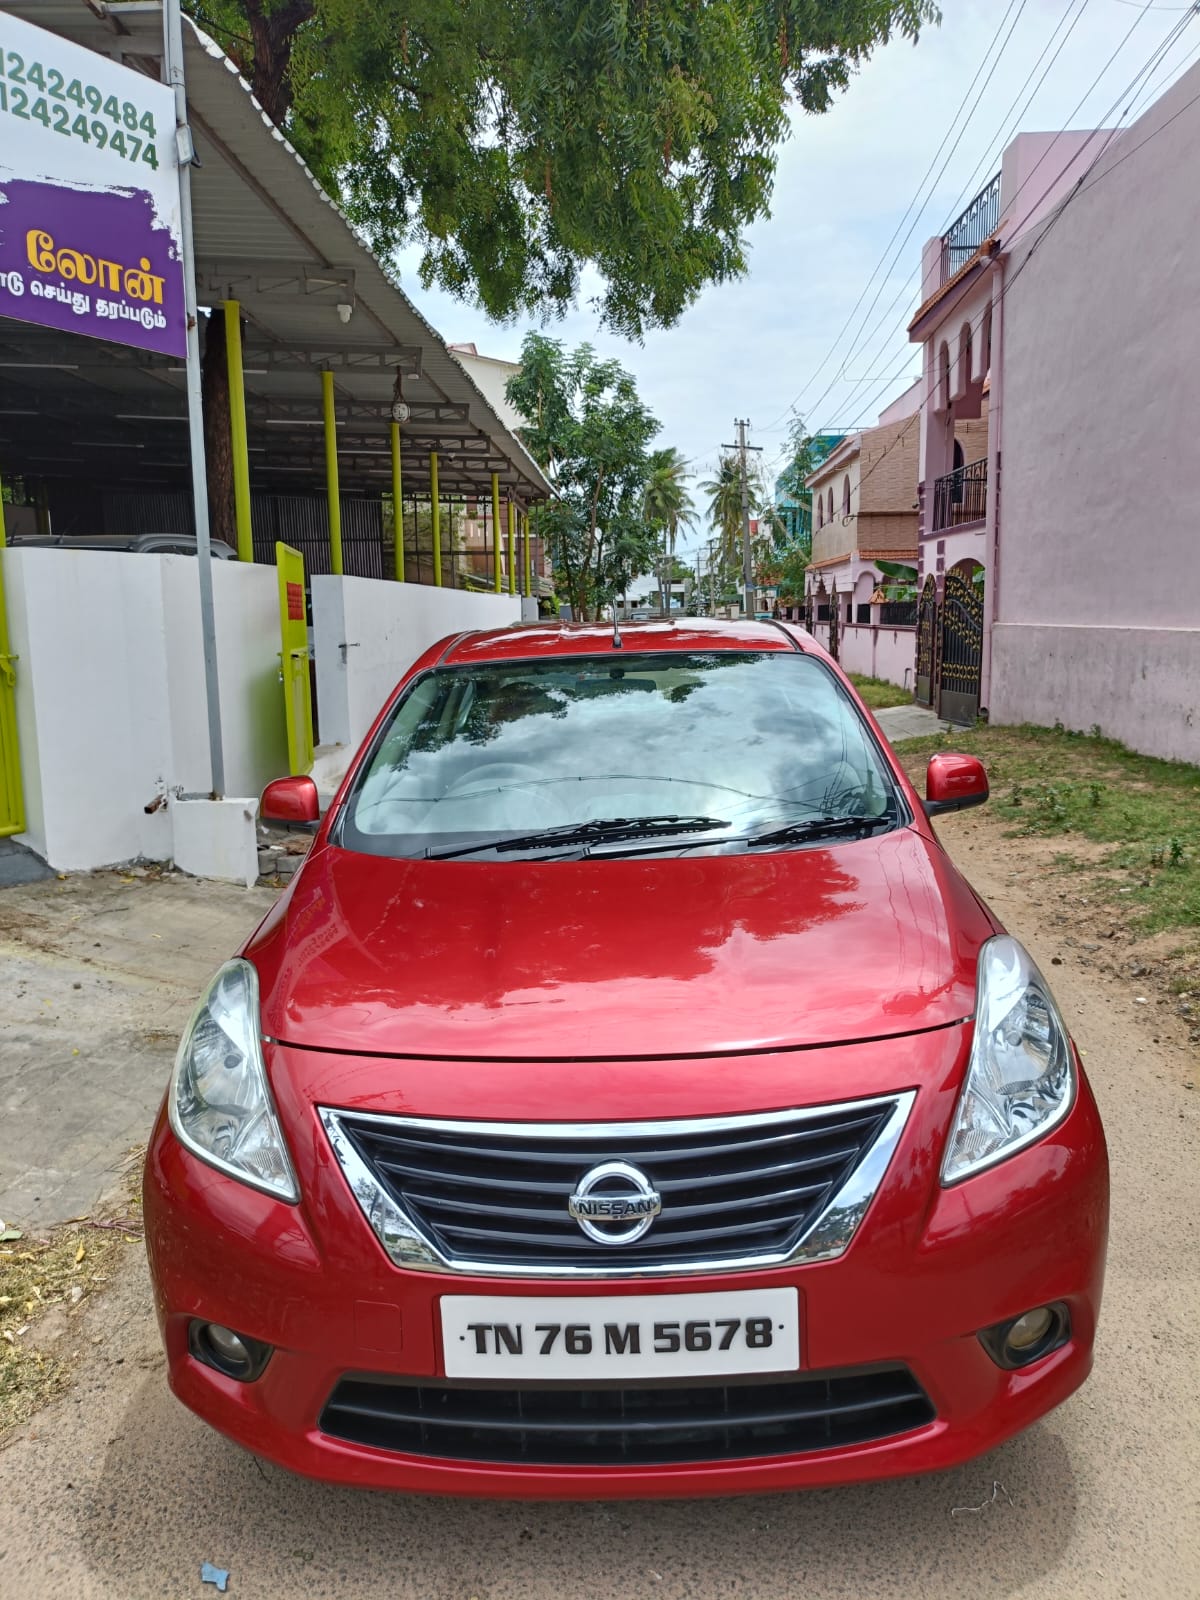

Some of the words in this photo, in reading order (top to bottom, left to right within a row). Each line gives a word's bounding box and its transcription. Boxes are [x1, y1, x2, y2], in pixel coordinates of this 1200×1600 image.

[26, 229, 165, 304] லோன்
[30, 282, 90, 314] செய்து
[96, 299, 167, 329] தரப்படும்
[578, 1201, 652, 1216] NISSAN
[467, 1323, 523, 1355] TN
[535, 1324, 592, 1355] 76
[604, 1324, 641, 1355] M
[654, 1317, 773, 1353] 5678
